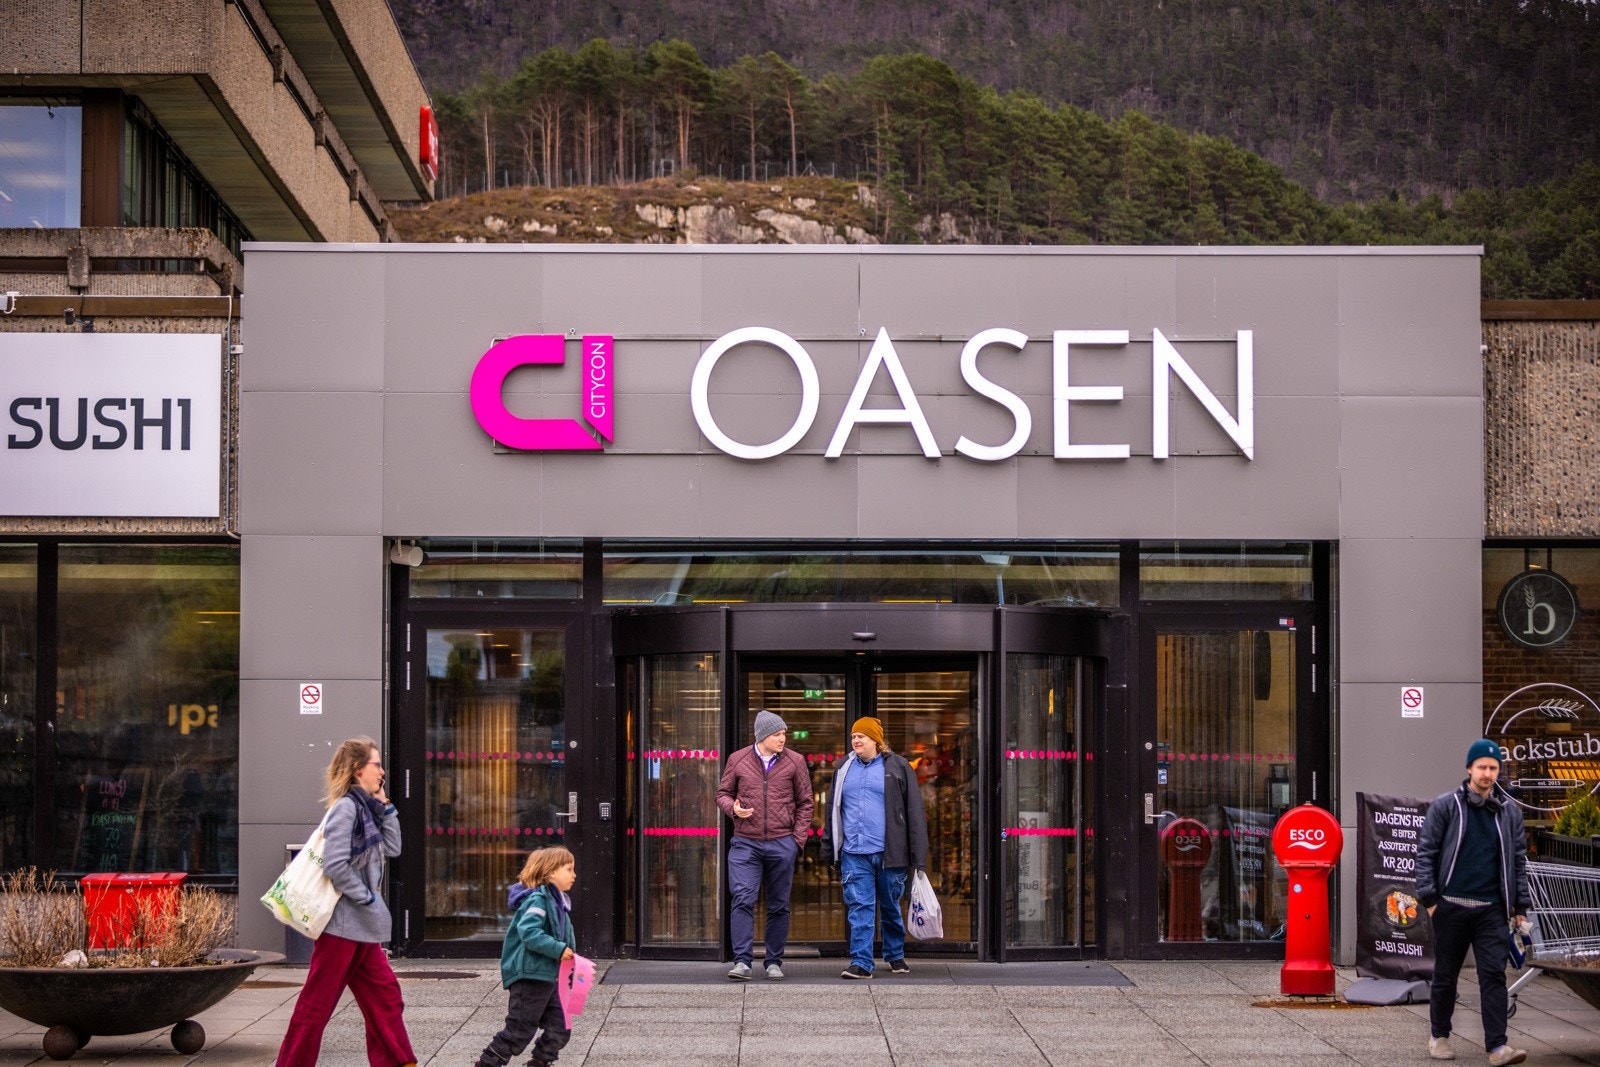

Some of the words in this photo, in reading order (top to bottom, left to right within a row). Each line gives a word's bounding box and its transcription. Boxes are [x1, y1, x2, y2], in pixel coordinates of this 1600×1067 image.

[590, 342, 606, 418] CITYCON
[690, 326, 1253, 461] OASEN
[8, 397, 191, 450] SUSHI
[1375, 811, 1411, 827] DAGENS
[1289, 829, 1325, 841] ESCO
[1391, 829, 1398, 838] 16
[1398, 830, 1417, 839] BITER
[1378, 841, 1411, 852] ASSOTERT
[1383, 856, 1396, 869] KR
[1397, 857, 1415, 870] 200
[1375, 940, 1397, 953] SABI
[1397, 943, 1423, 957] SUSHI
